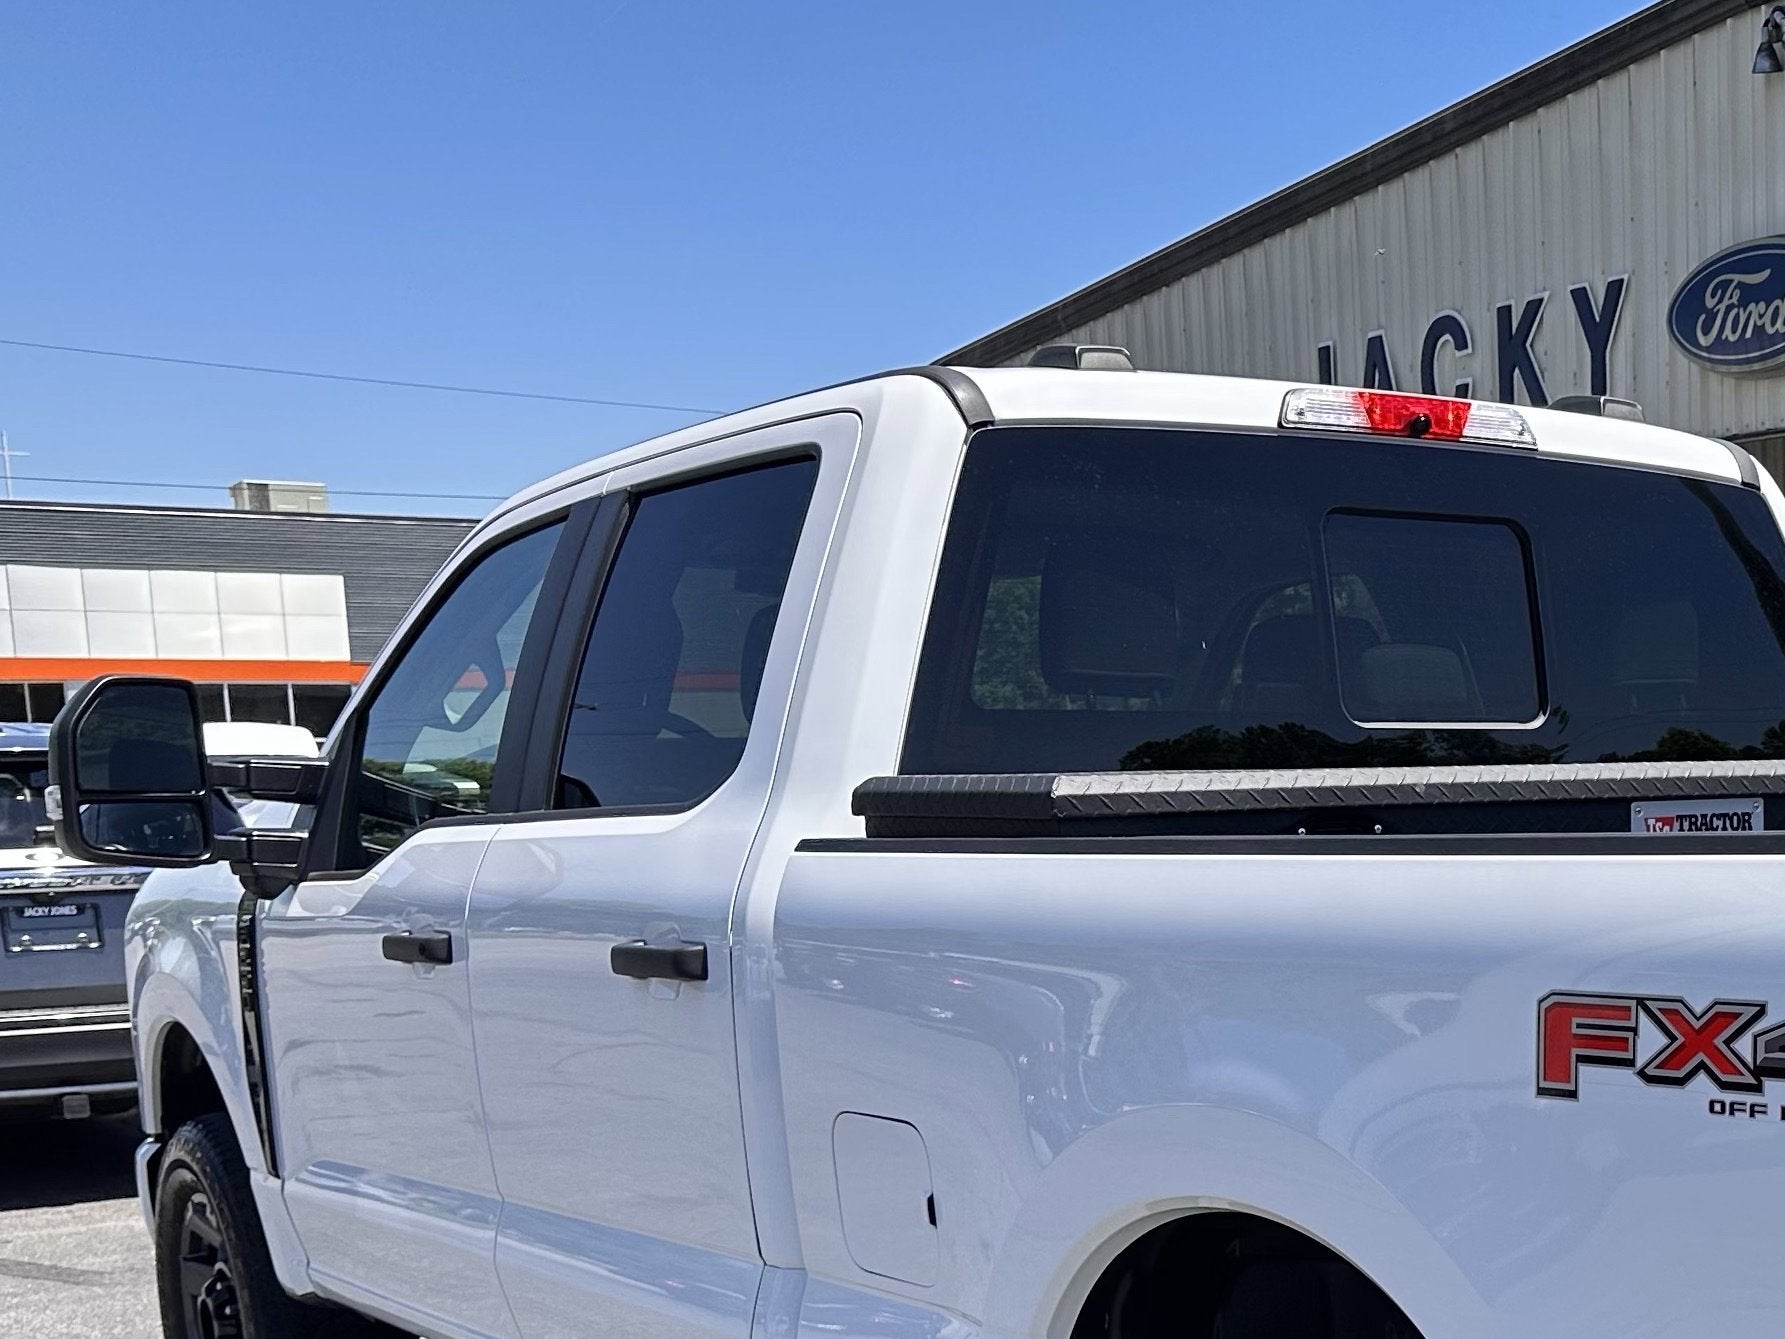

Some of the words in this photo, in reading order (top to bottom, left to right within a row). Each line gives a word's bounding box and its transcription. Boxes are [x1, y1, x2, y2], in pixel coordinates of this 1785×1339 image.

[1675, 812, 1753, 832] TRACTOR
[23, 906, 49, 917] JACKY
[51, 905, 77, 915] JONES
[1709, 1100, 1768, 1118] OFF
